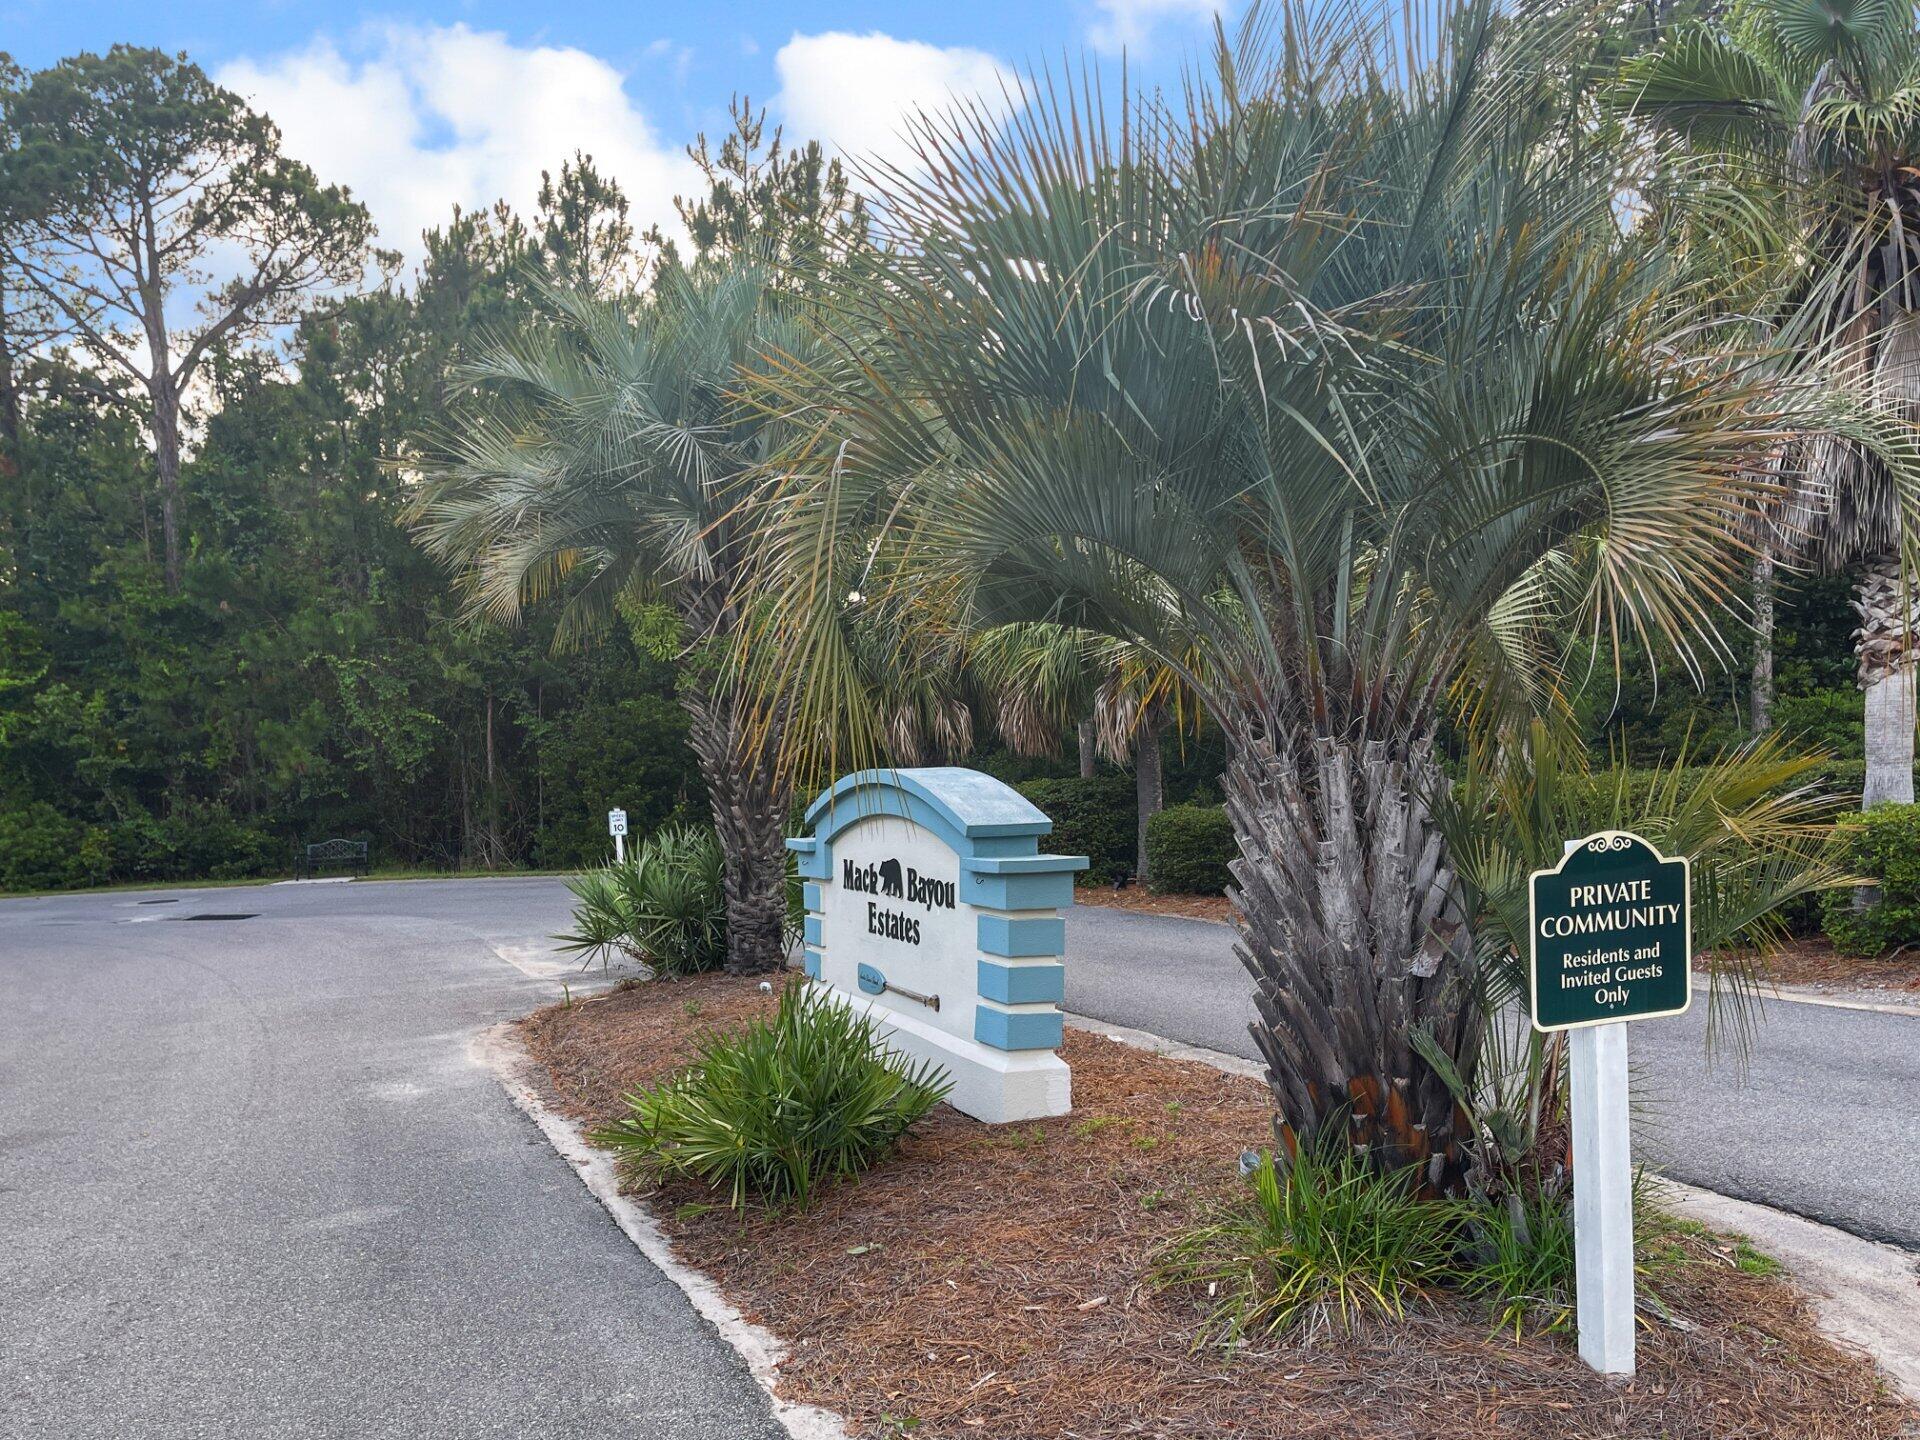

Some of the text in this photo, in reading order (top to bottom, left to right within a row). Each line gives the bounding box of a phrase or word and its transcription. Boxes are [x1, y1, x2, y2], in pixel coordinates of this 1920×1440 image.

[613, 824, 624, 832] 10
[843, 859, 956, 912] Mack Bayou
[1570, 880, 1651, 908] PRIVATE
[868, 901, 921, 946] Estates
[1540, 903, 1681, 938] COMMUNITY
[1563, 941, 1661, 969] Residents and
[1561, 963, 1663, 989] Invited Guests
[1594, 985, 1630, 1006] Only
